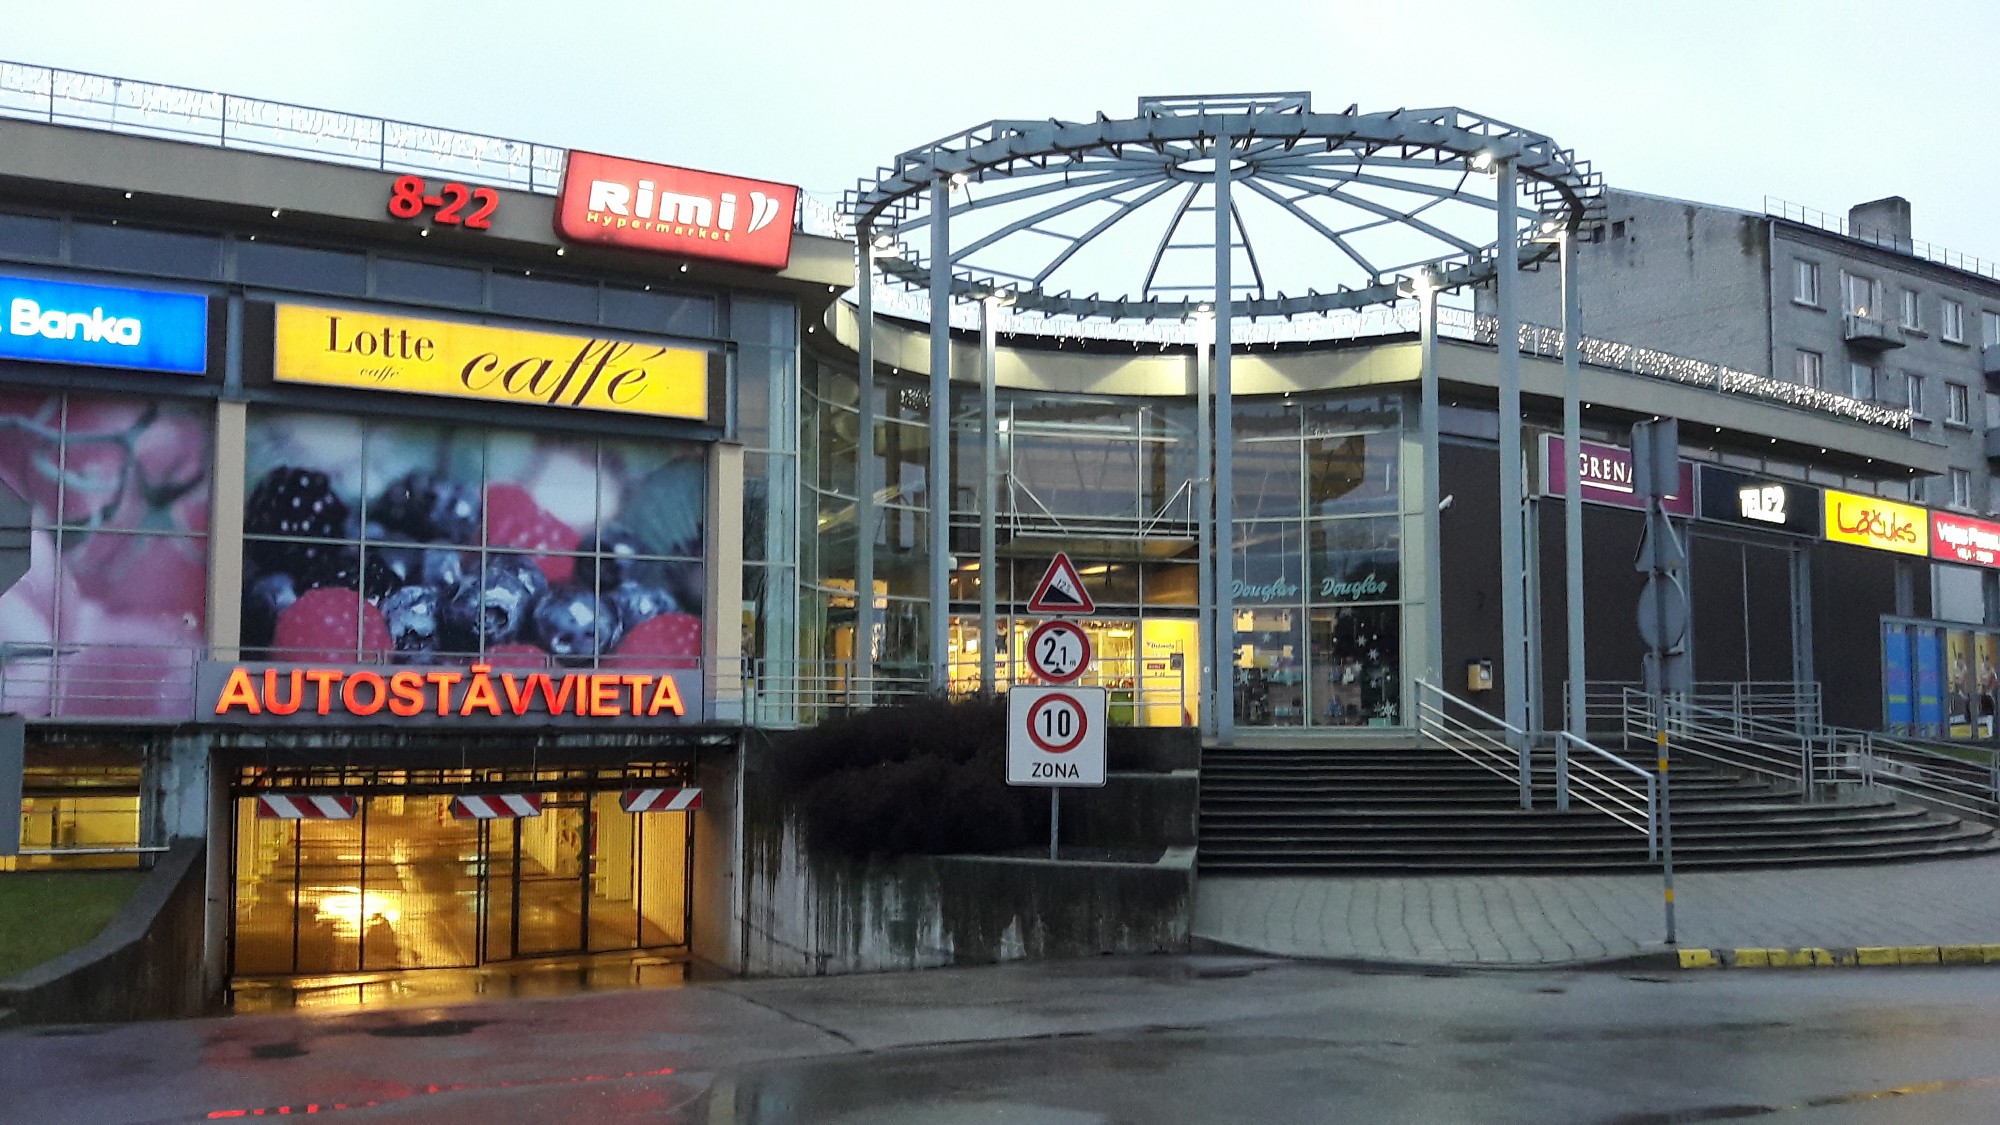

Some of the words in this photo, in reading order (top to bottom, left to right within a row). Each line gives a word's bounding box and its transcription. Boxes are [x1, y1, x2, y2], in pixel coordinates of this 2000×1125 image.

[389, 175, 498, 229] 8-22
[588, 179, 736, 231] Rimi
[586, 212, 731, 241] Hypermarket
[10, 298, 141, 345] Banka
[325, 316, 435, 362] Lotte
[215, 665, 686, 717] AUTOSTĀVVIETA
[1043, 709, 1071, 737] 10
[1032, 763, 1080, 778] ZONA
